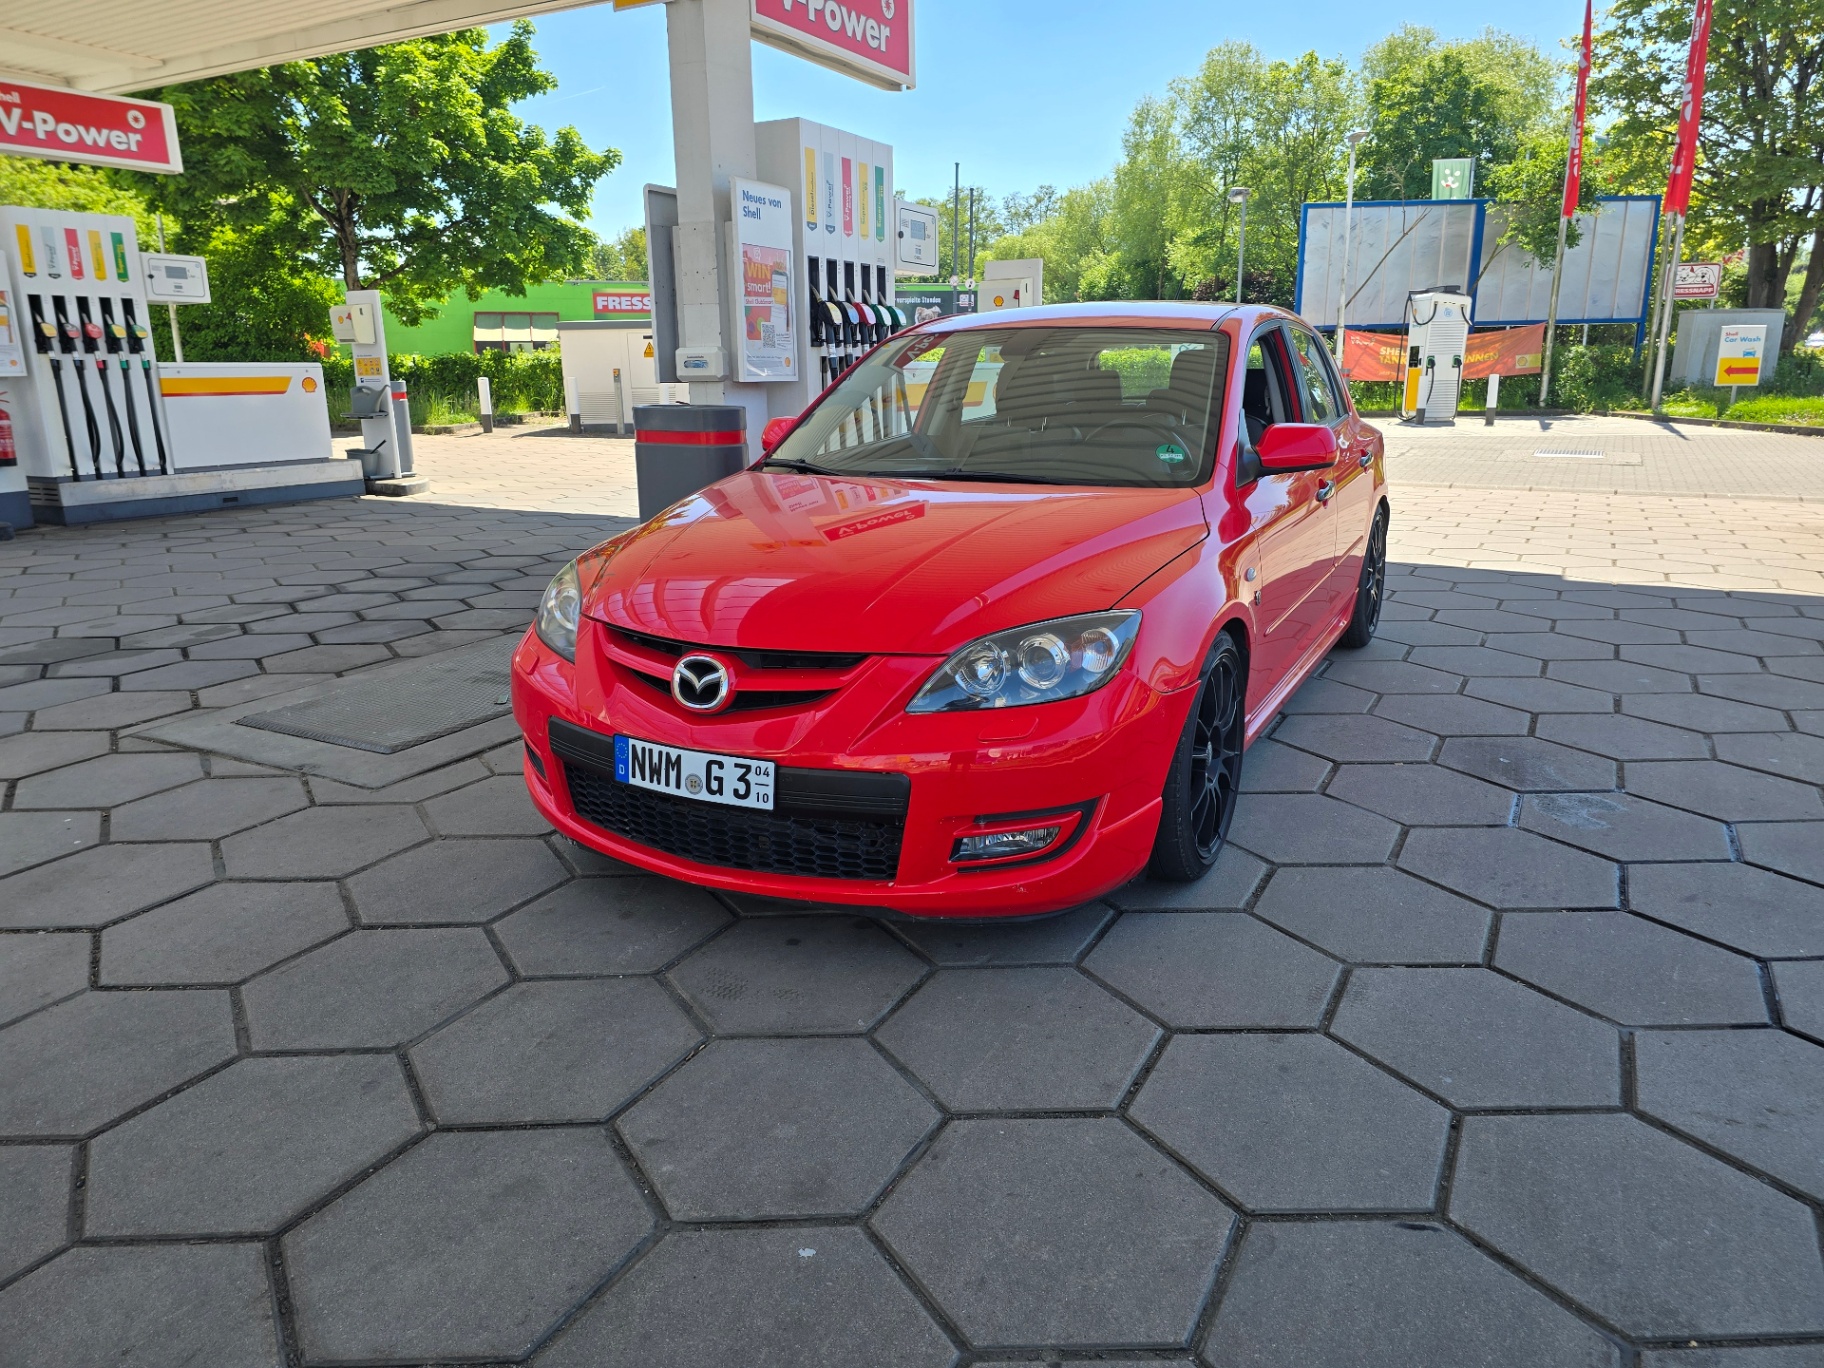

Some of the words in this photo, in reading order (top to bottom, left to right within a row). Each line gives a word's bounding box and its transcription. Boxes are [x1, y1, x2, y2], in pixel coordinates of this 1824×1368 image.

[783, 0, 890, 52] -Power
[0, 105, 142, 152] V-Power
[742, 190, 766, 205] Neues
[768, 198, 782, 209] von
[743, 205, 761, 220] Shell
[746, 262, 771, 280] WIN
[747, 281, 771, 293] smart!
[1379, 346, 1407, 356] SHEL
[1166, 445, 1175, 454] 4
[618, 764, 625, 775] D
[631, 744, 682, 790] NWM
[755, 765, 770, 778] 04
[755, 791, 770, 804] 10
